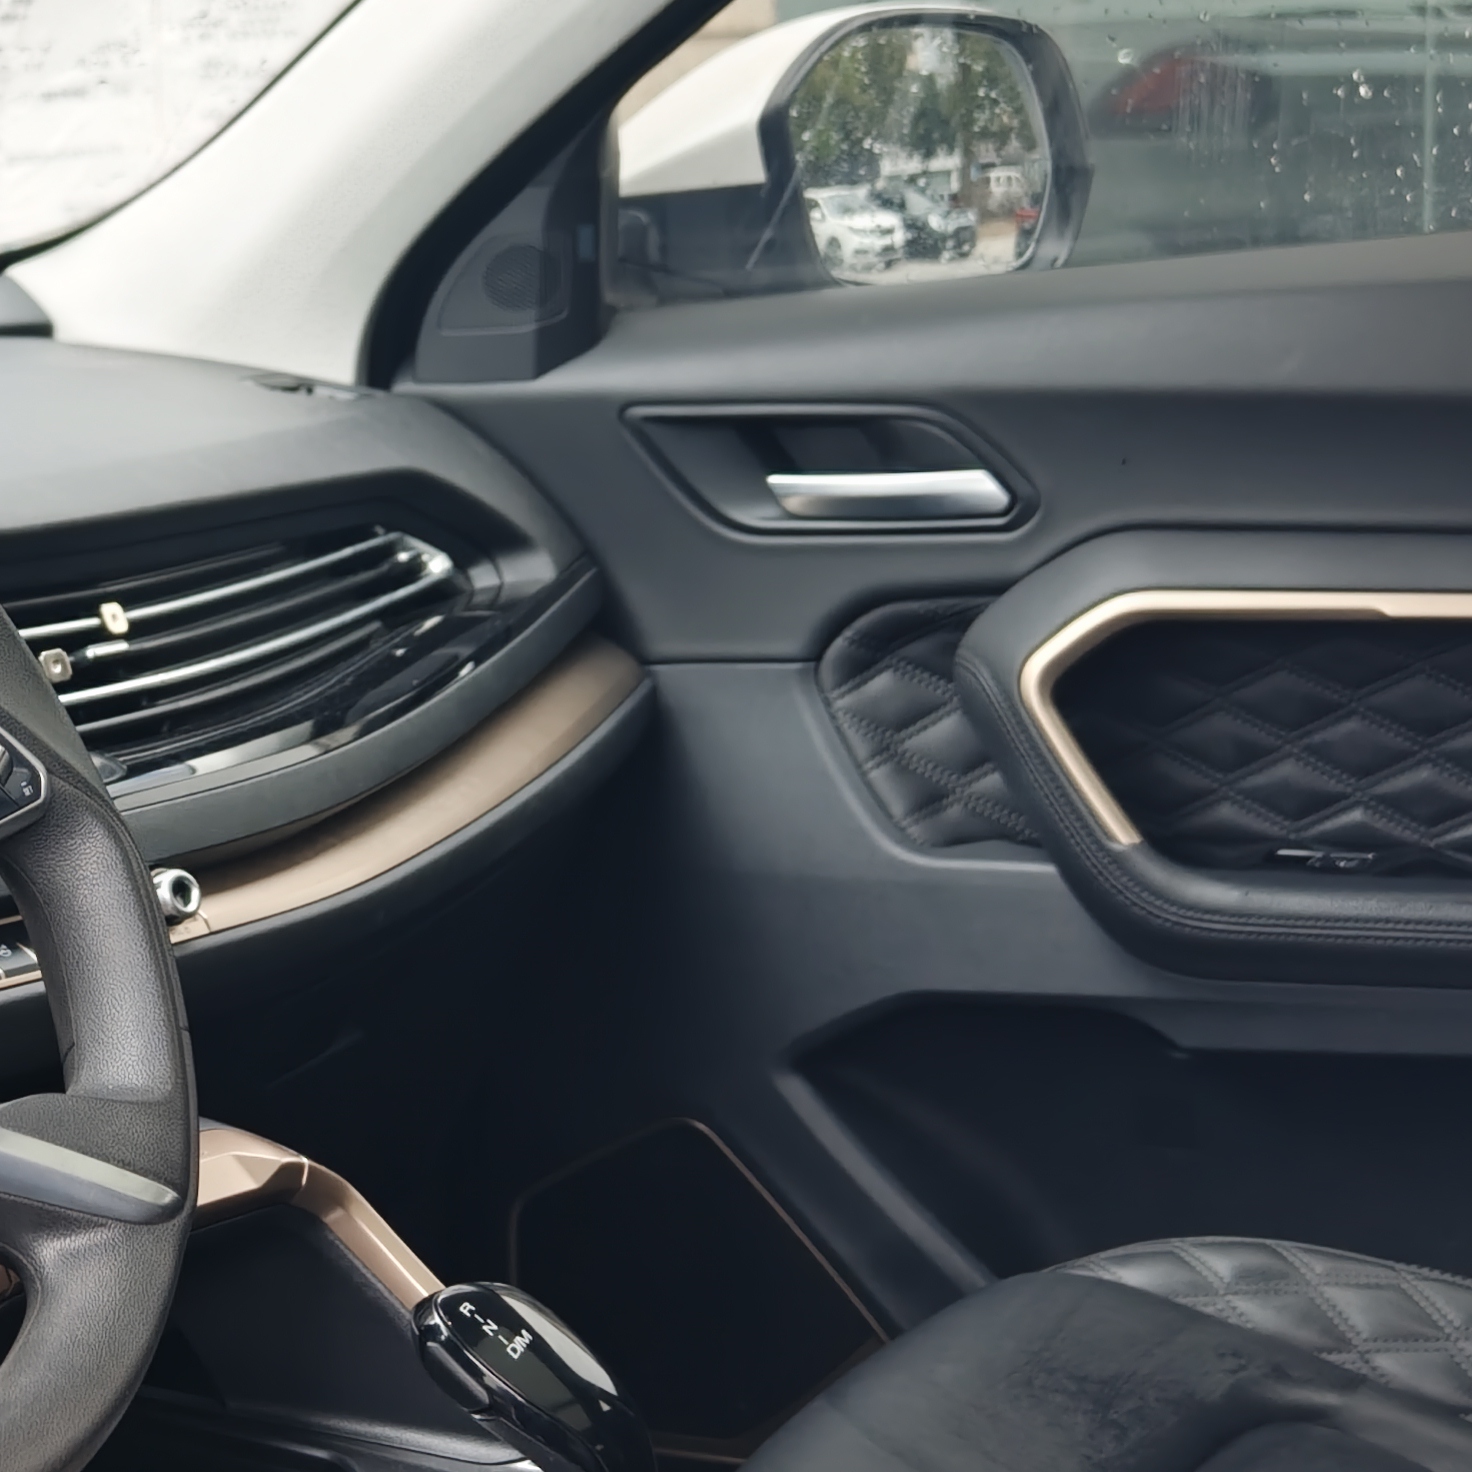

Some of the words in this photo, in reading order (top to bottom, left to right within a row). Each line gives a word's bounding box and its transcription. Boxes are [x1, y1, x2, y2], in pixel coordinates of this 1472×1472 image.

[459, 1301, 476, 1318] R
[481, 1318, 499, 1337] N
[506, 1329, 534, 1360] D/M
